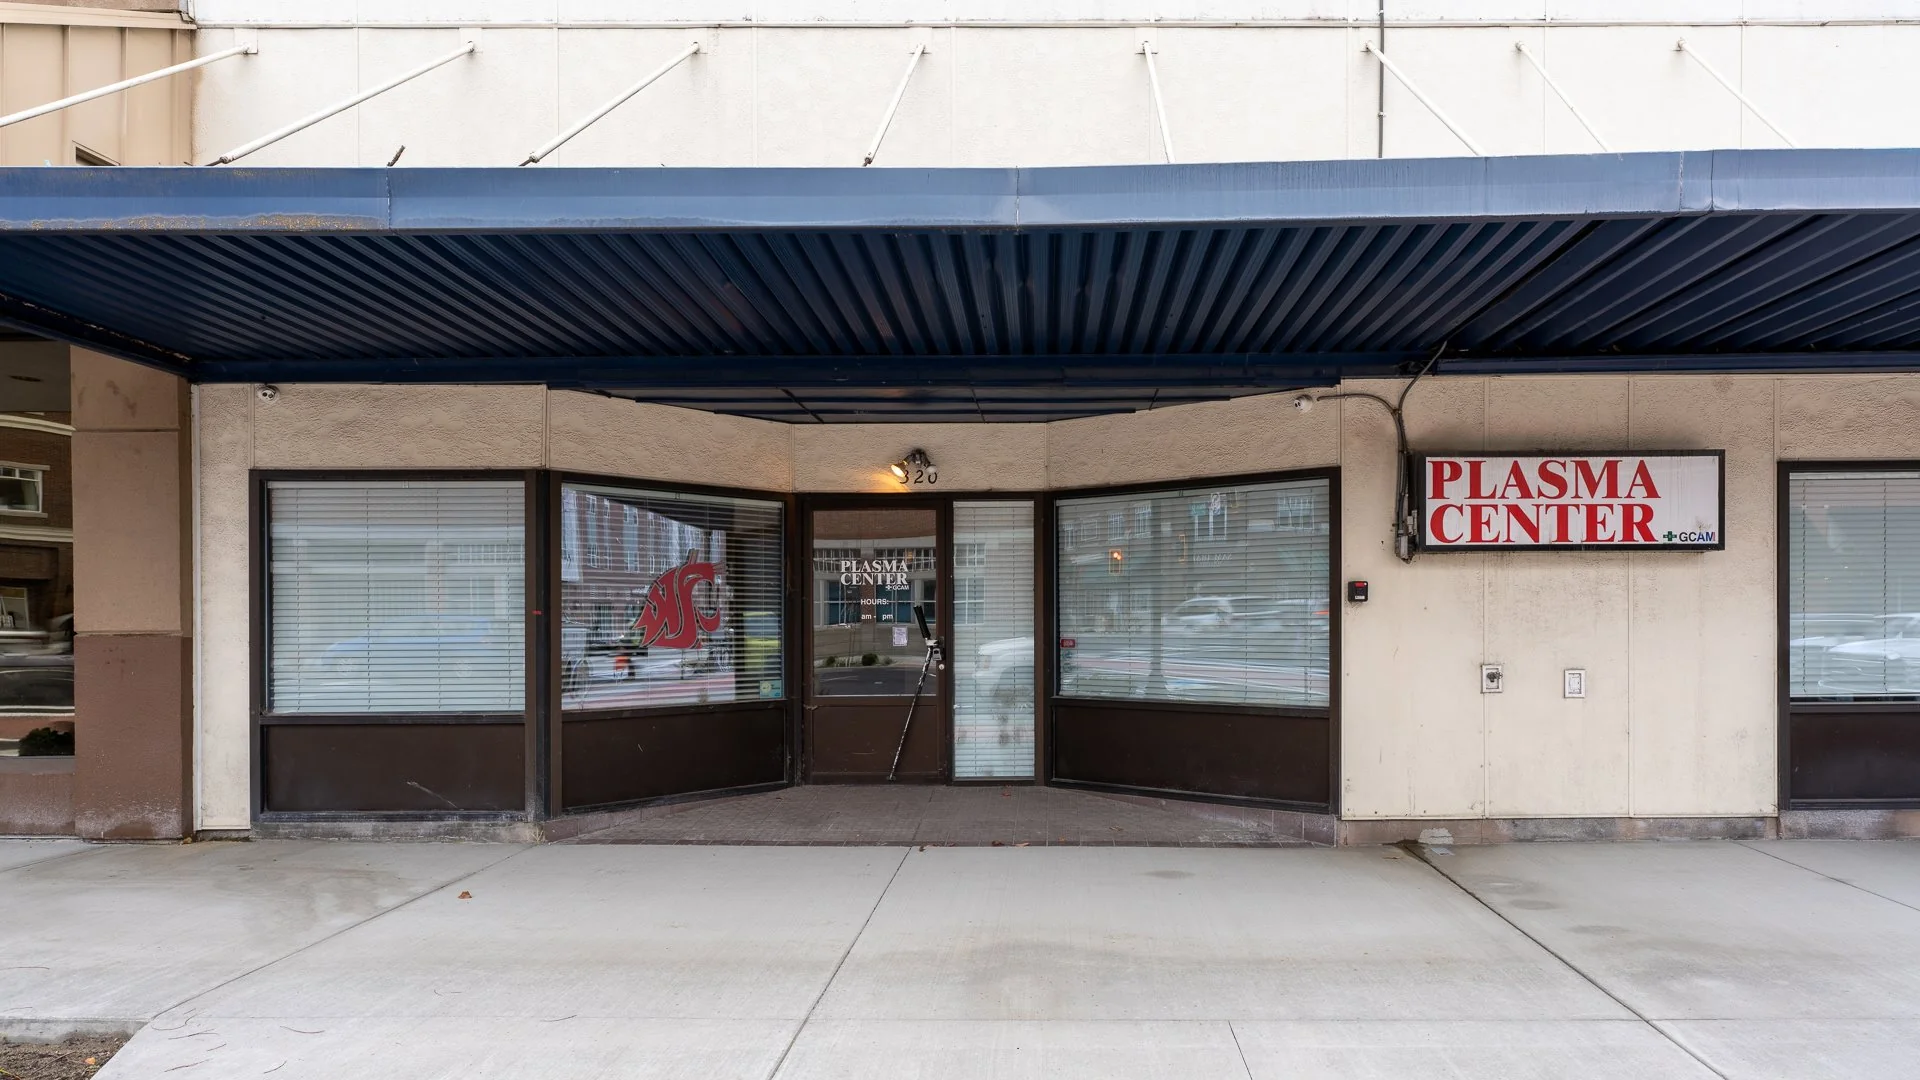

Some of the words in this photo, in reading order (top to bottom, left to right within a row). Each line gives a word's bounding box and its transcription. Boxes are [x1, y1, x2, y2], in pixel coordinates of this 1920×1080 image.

[899, 469, 938, 485] 320
[1427, 459, 1662, 500] PLASMA
[1430, 503, 1659, 544] CENTER
[1679, 531, 1716, 542] GCAM
[840, 559, 909, 573] PLASMA
[840, 572, 908, 586] CENTER
[882, 613, 894, 621] pm
